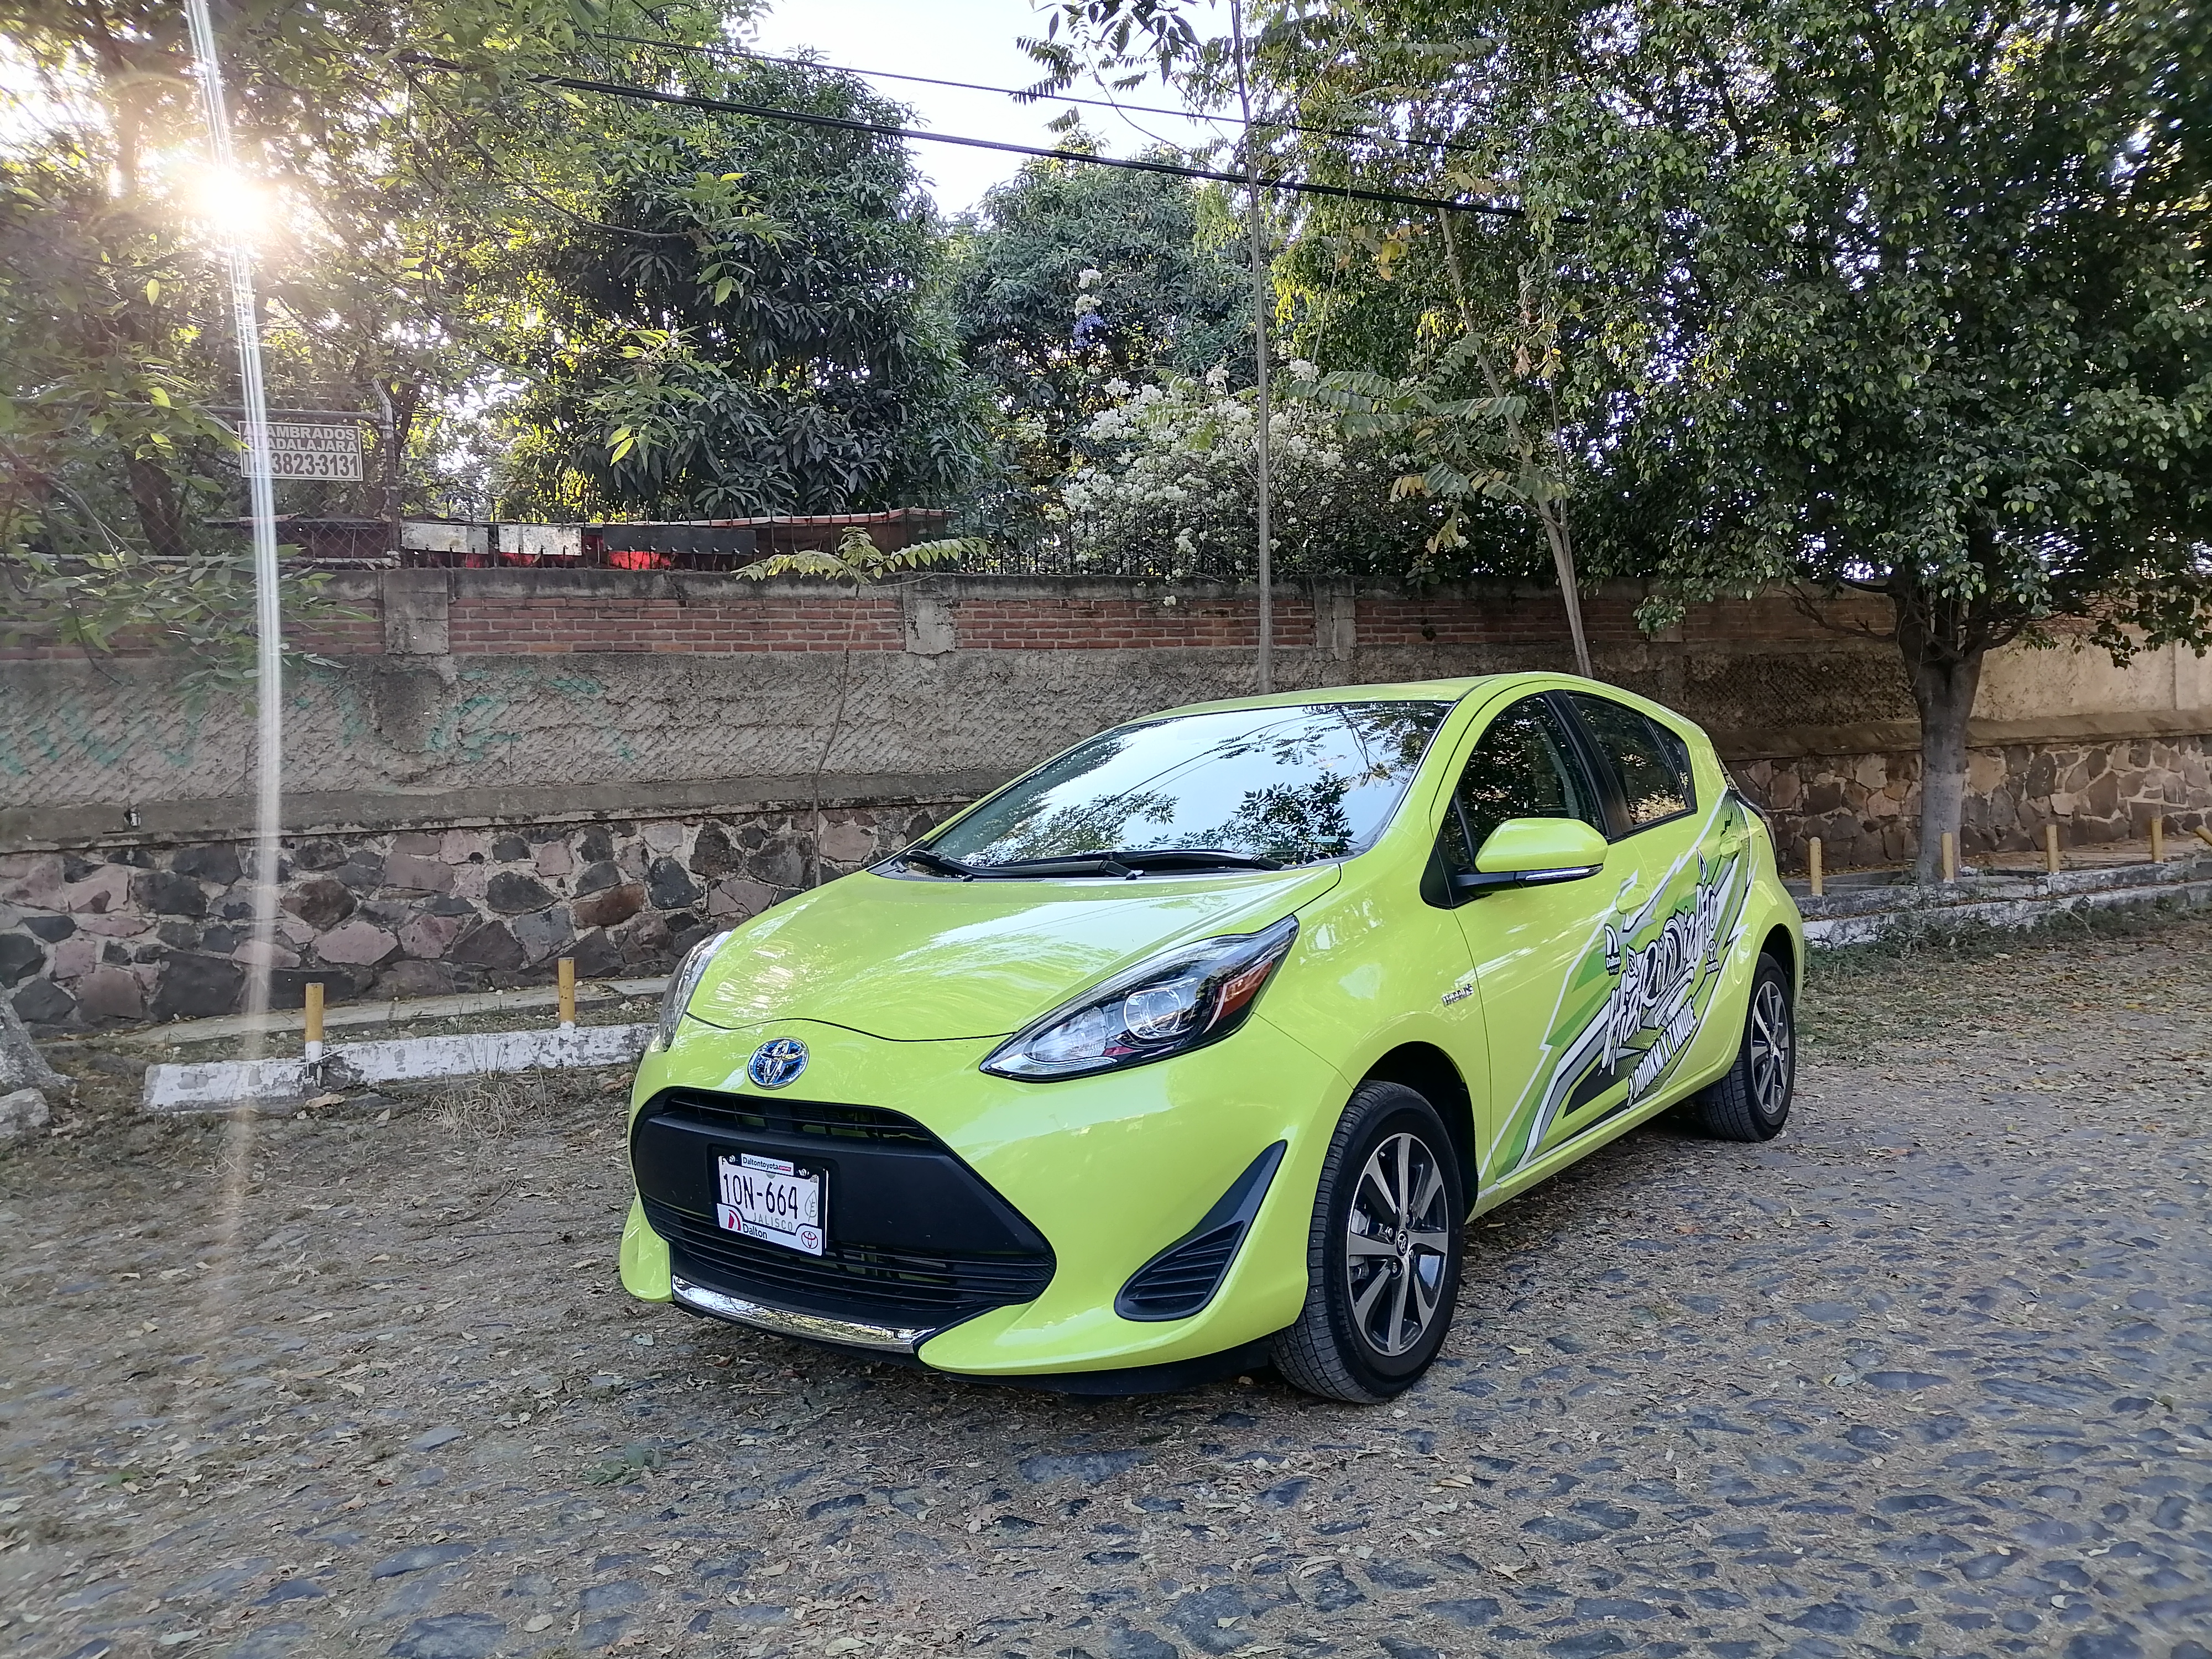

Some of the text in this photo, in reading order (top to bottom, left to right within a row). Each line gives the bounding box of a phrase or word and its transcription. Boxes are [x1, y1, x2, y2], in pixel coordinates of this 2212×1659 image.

[243, 437, 357, 452] GUADALAJARA
[272, 453, 358, 476] 3823-3131
[1667, 997, 1697, 1053] TANQUE
[753, 1213, 792, 1231] JALISCO
[743, 1224, 768, 1239] Dalton
